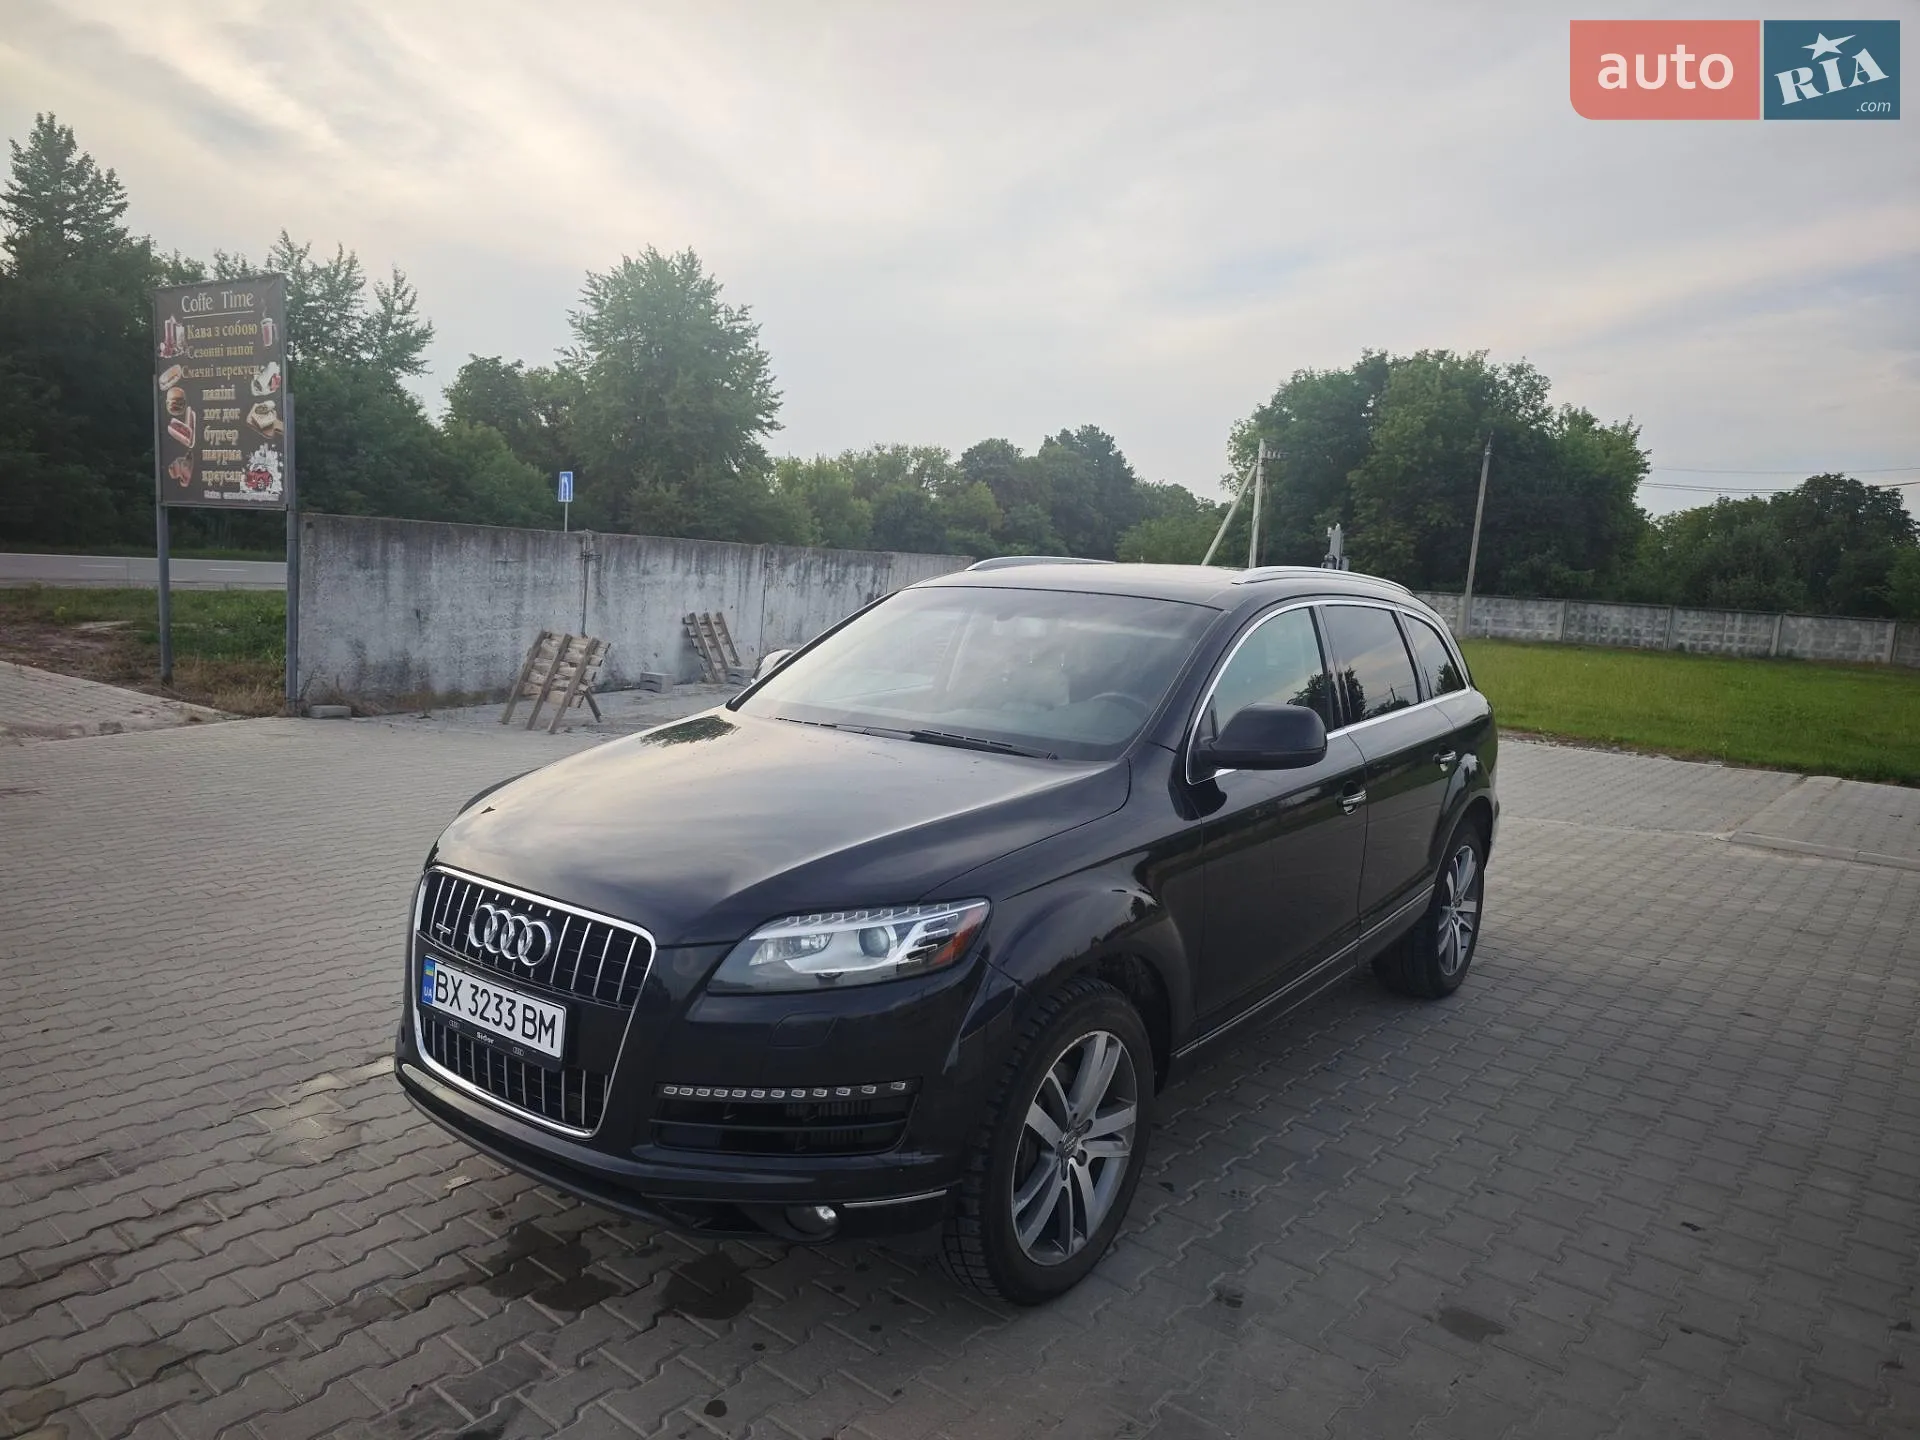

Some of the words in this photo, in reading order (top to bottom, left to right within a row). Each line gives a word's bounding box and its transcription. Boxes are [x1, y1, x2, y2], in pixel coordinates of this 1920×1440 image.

[181, 292, 213, 313] Coffe
[221, 290, 254, 309] Time
[187, 324, 212, 340] Кава
[214, 326, 220, 337] з
[222, 319, 258, 337] собою
[187, 343, 224, 359] Сезонні
[226, 341, 254, 356] напої
[181, 364, 214, 379] Смачні
[204, 425, 239, 446] бургер
[423, 984, 433, 998] UA
[434, 969, 463, 1012] BX
[467, 983, 517, 1032] 3233
[521, 1003, 556, 1049] BM
